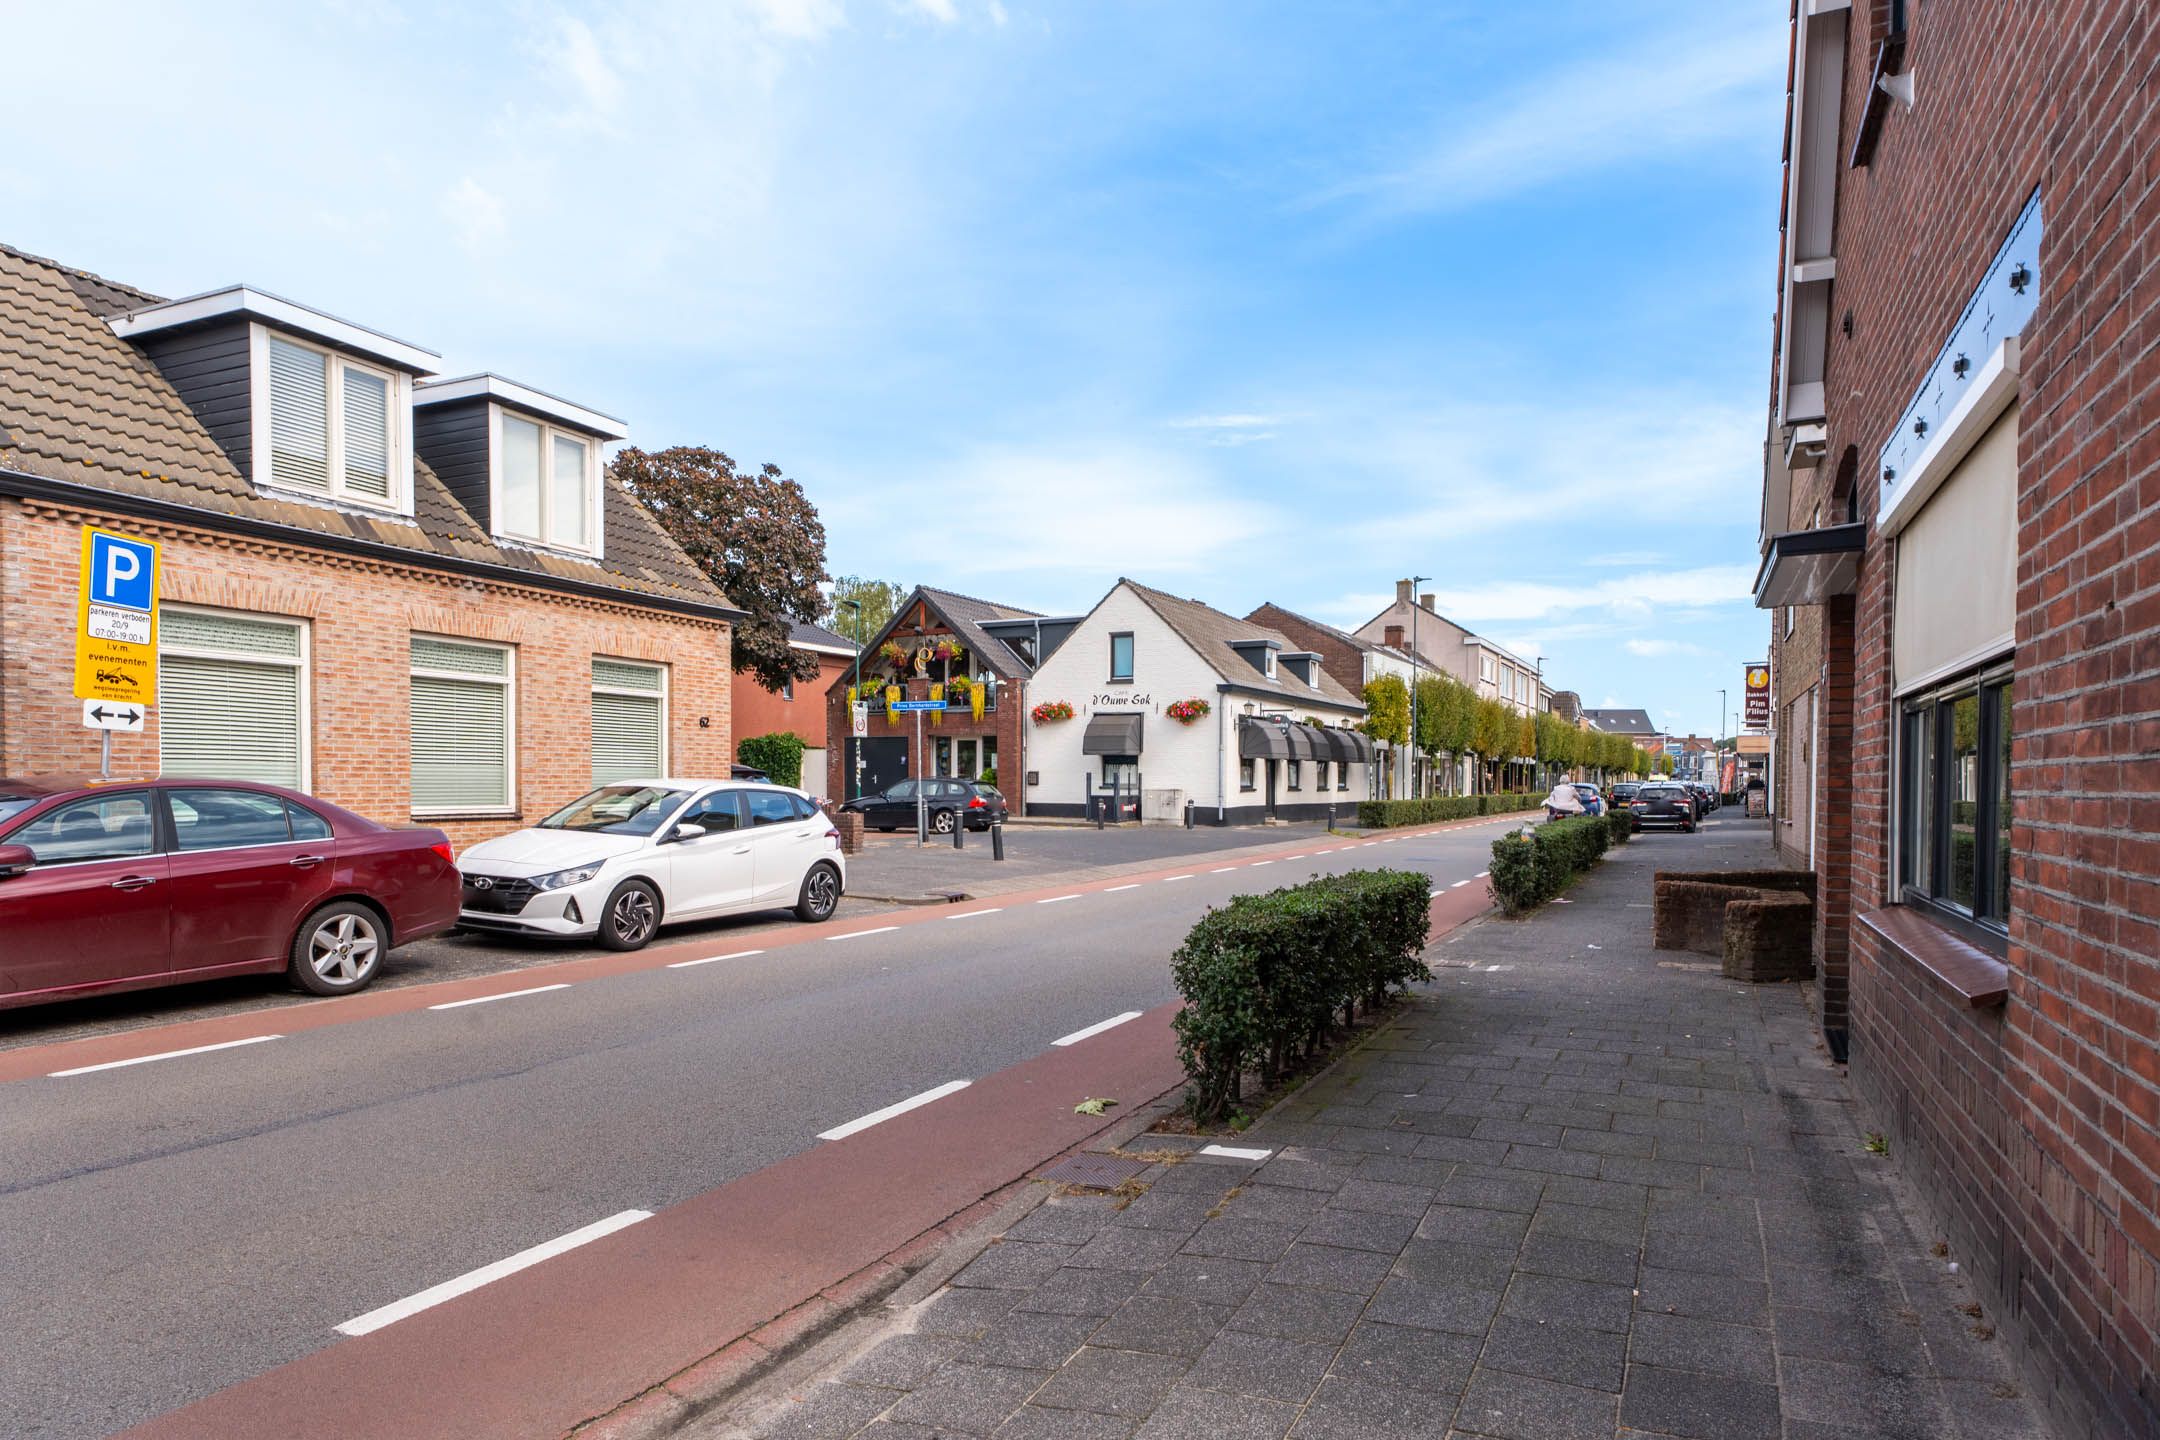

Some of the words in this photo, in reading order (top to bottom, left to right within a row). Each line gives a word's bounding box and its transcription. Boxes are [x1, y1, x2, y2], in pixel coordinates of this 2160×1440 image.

[106, 544, 140, 597] P
[90, 607, 119, 618] parkeren
[121, 612, 149, 623] verboden
[111, 619, 129, 629] 20/9
[89, 653, 147, 667] evenementen
[1093, 694, 1128, 705] d'Ouwe
